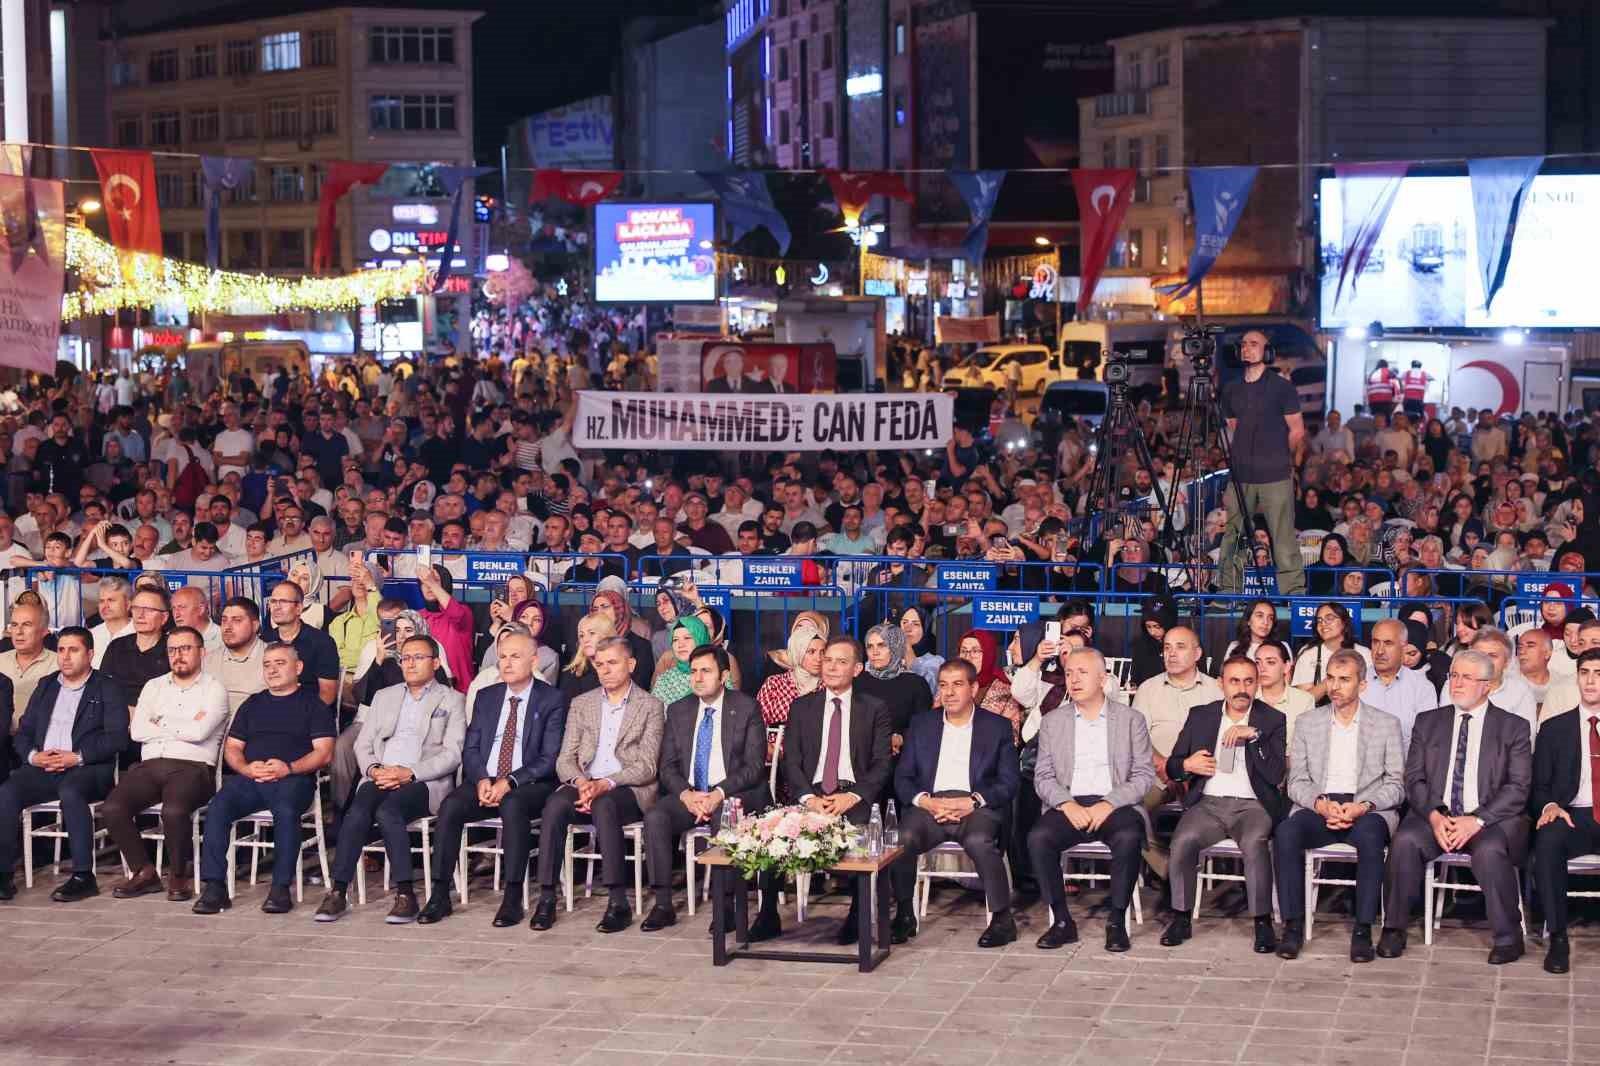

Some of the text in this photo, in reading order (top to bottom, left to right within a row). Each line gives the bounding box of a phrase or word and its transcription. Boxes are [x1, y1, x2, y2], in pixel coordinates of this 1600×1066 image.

[587, 415, 609, 440] HZ.
[813, 401, 865, 443] CAN
[874, 400, 939, 441] FEDA
[472, 561, 518, 571] ESENLER
[749, 564, 796, 574] ESENLER
[477, 572, 512, 581] ZABIT
[943, 571, 990, 580] ESENLER
[754, 576, 791, 586] ZABITA
[980, 601, 1033, 612] ESENLER
[985, 614, 1027, 625] ZABITA
